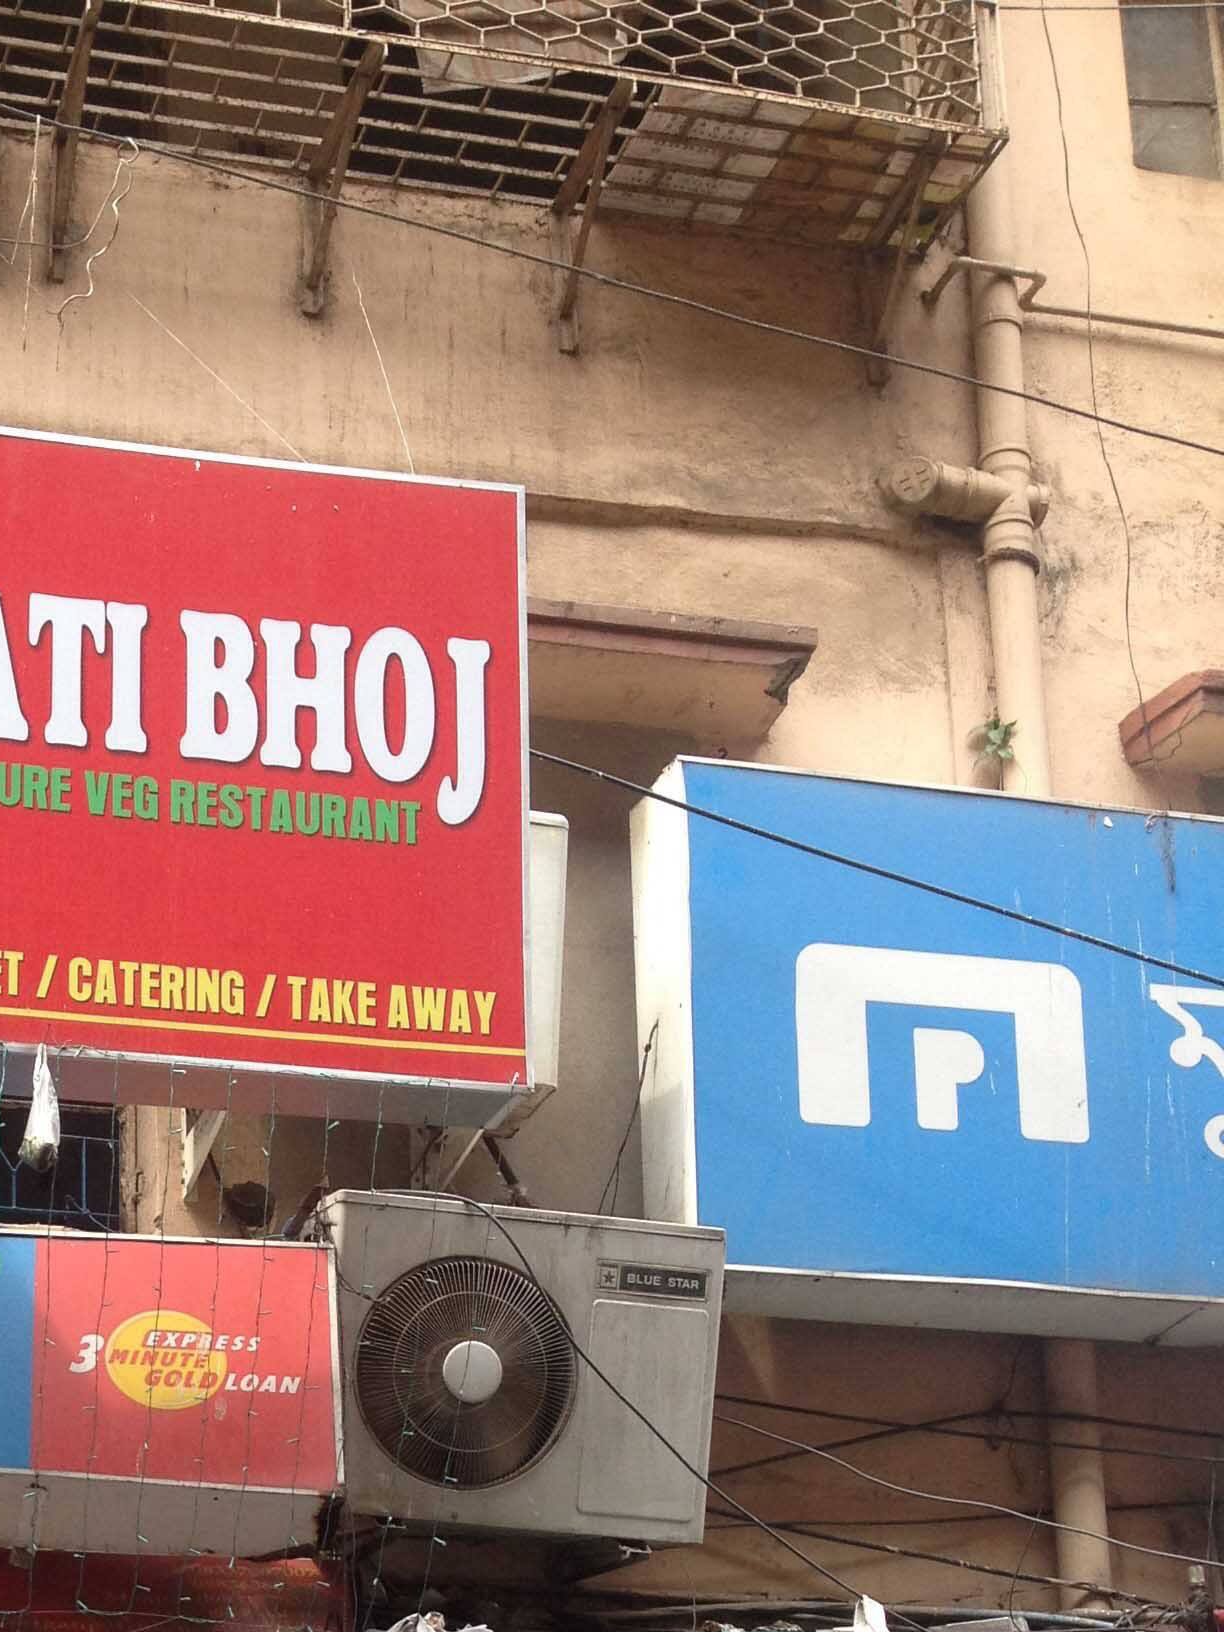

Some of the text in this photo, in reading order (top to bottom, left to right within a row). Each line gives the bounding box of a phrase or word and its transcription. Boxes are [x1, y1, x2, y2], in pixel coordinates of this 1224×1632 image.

[179, 607, 491, 826] BHOJ
[84, 770, 160, 822] VEG
[170, 777, 421, 845] RESTAURANT
[67, 957, 246, 1017] CATERING
[285, 975, 377, 1028] TAKE
[386, 984, 497, 1036] AWAY
[626, 1272, 700, 1290] BLUE STAR
[68, 1333, 211, 1374] 3 MINUTE
[145, 1330, 262, 1353] EXPRESS
[143, 1368, 302, 1395] GOLD LOAN
